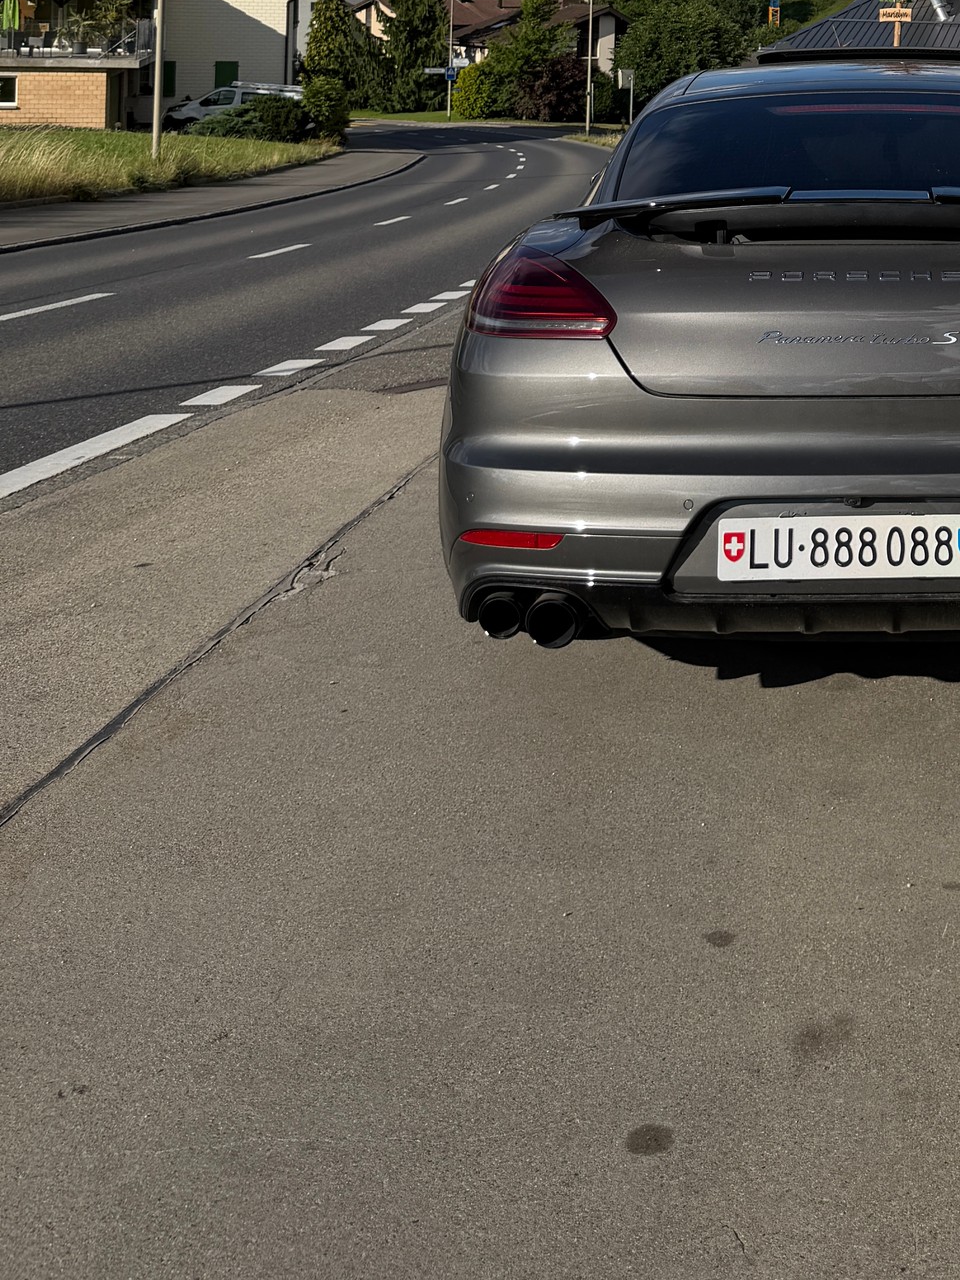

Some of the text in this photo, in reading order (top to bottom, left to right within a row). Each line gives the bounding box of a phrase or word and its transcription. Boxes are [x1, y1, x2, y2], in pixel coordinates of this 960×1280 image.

[757, 330, 960, 345] Panamera Turbo S
